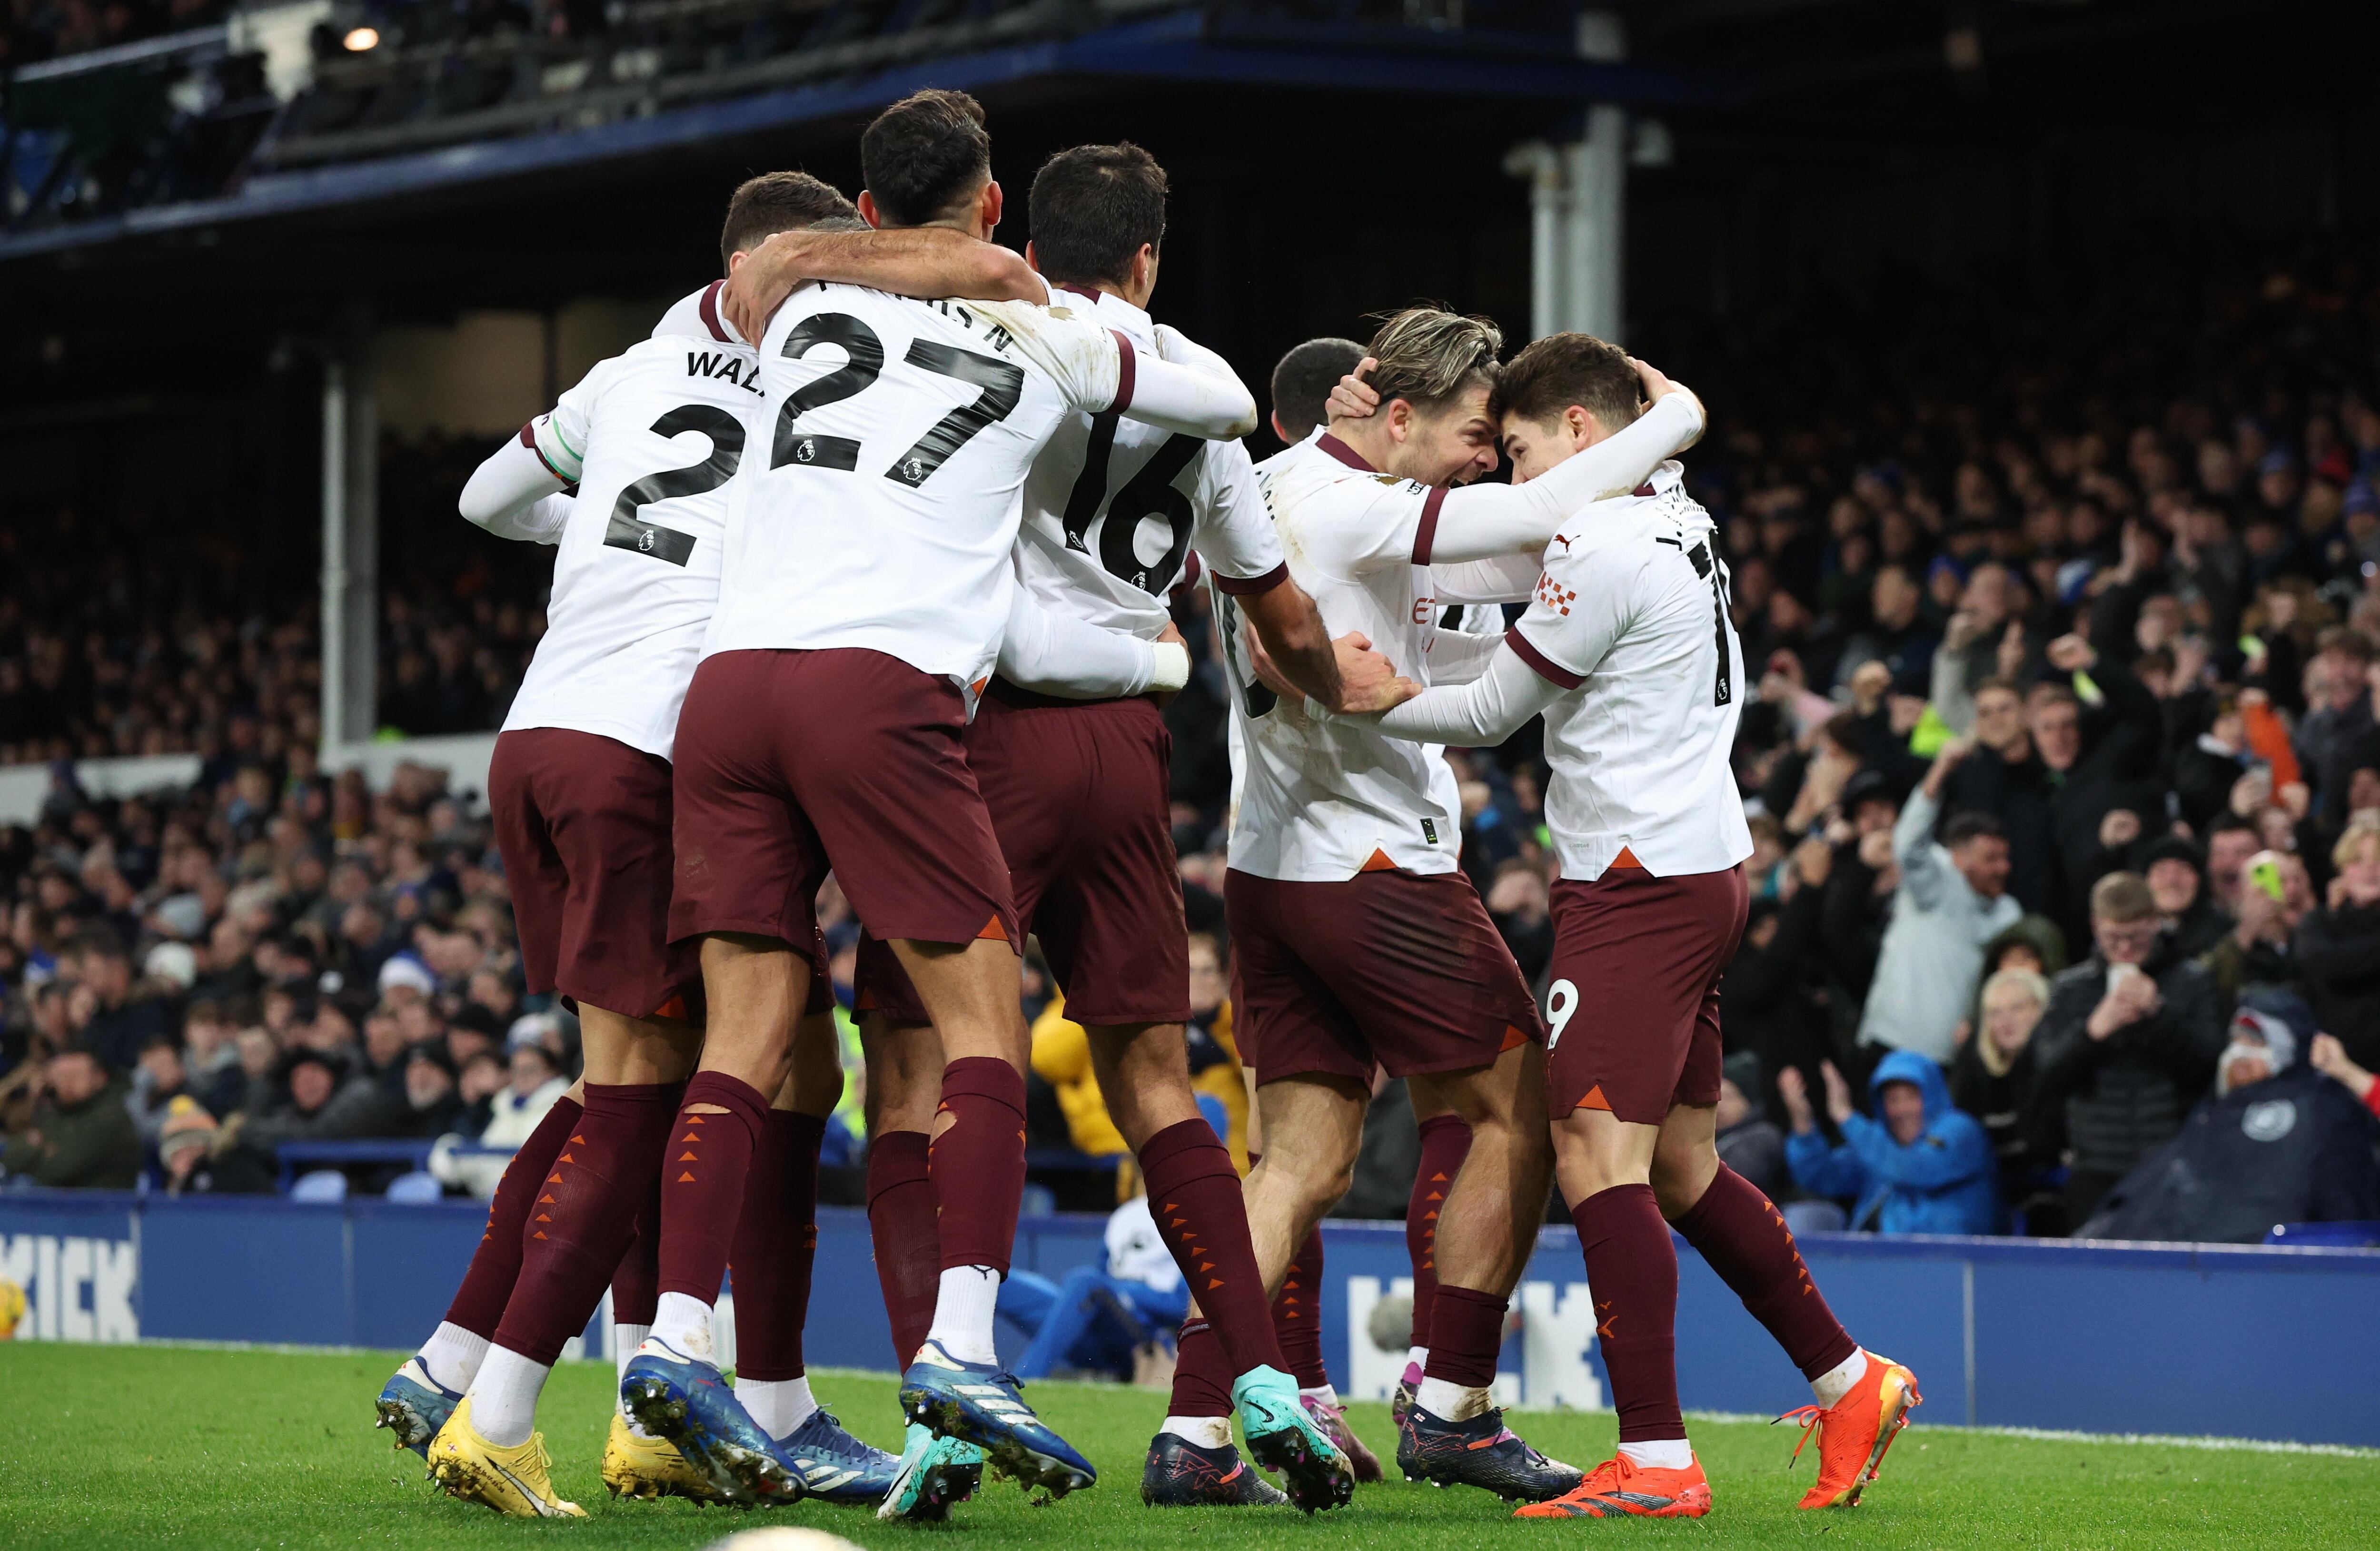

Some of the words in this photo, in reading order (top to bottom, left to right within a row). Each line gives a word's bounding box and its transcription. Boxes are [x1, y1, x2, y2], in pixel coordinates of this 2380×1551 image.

[688, 352, 765, 397] WAL
[769, 312, 1025, 488] 27
[603, 404, 746, 567] 2
[1062, 412, 1206, 597] 16
